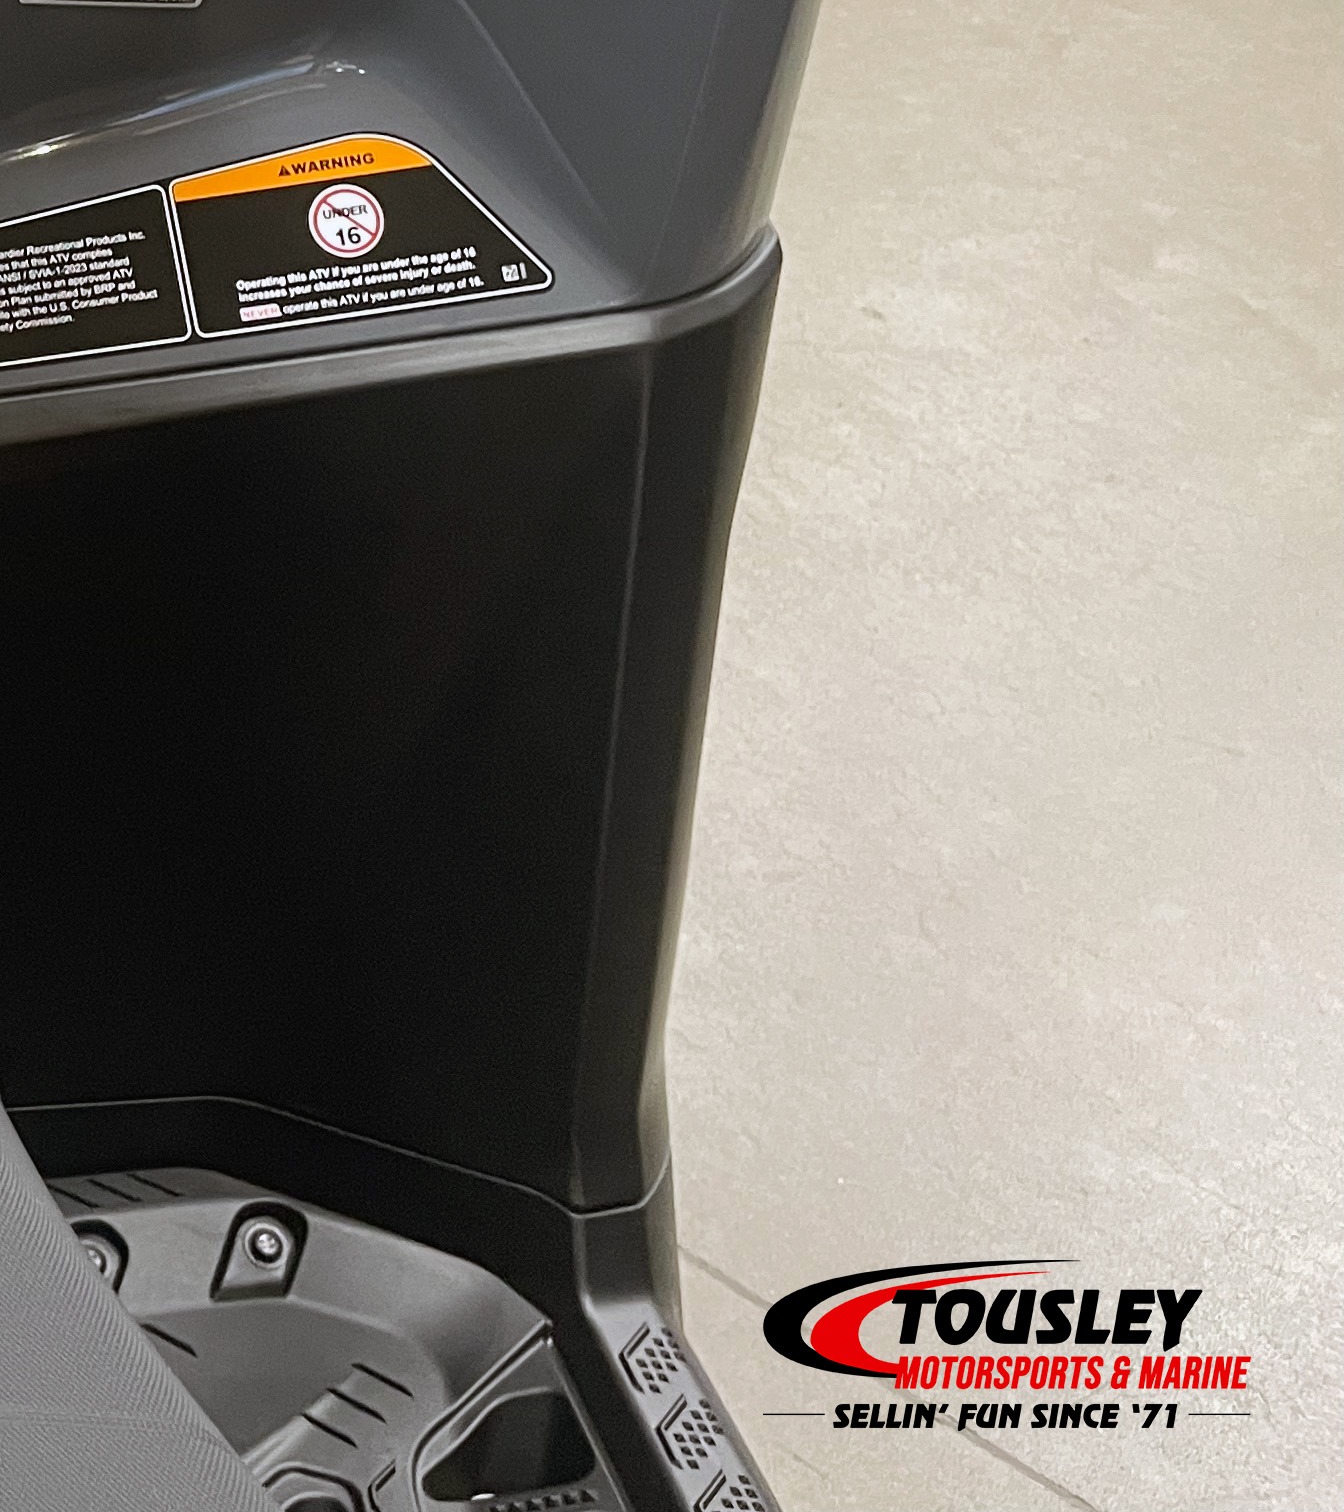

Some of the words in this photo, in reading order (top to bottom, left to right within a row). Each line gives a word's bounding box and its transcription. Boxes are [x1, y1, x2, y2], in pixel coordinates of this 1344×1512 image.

[292, 152, 375, 175] WARNING
[323, 205, 368, 219] UNDER
[26, 239, 84, 255] Recreational
[86, 234, 127, 248] Products
[128, 231, 146, 241] Inc.
[336, 227, 361, 246] 16
[12, 258, 29, 269] that
[31, 257, 47, 267] this
[50, 253, 70, 264] ATV
[72, 248, 112, 261] complies
[89, 256, 130, 271] standard
[236, 276, 286, 291] Operating
[287, 272, 307, 283] this
[309, 267, 330, 281] ATV
[332, 266, 339, 277] if
[341, 265, 360, 278] you
[362, 262, 379, 273] are
[380, 257, 409, 270] under
[411, 255, 428, 265] the
[430, 252, 448, 264] age
[451, 248, 461, 260] of
[464, 246, 476, 258] 16
[8, 281, 40, 295] subject
[42, 279, 52, 289] to
[54, 278, 66, 288] an
[68, 271, 111, 287] approved
[112, 267, 133, 280] ATV
[238, 288, 287, 302] increases
[289, 284, 312, 298] your
[314, 279, 350, 292] chance
[352, 275, 363, 286] of
[365, 272, 398, 285] severe
[400, 266, 428, 280] injury
[431, 265, 442, 275] or
[444, 260, 476, 274] death.
[11, 296, 32, 307] Plan
[34, 289, 78, 303] submitted
[80, 287, 92, 298] by
[94, 283, 115, 294] BRP
[118, 280, 136, 291] and
[12, 307, 31, 318] with
[32, 306, 47, 316] the
[72, 295, 119, 310] Consumer
[121, 289, 158, 303] Product
[243, 308, 278, 318] NEVER
[283, 301, 319, 315] operate
[320, 296, 338, 308] this
[340, 293, 360, 306] ATV
[362, 292, 369, 303] if
[371, 291, 388, 304] you
[390, 288, 406, 298] are
[408, 284, 434, 296] under
[437, 282, 455, 293] age
[457, 278, 466, 289] of
[468, 275, 484, 287] 16.
[16, 314, 75, 330] Commission.
